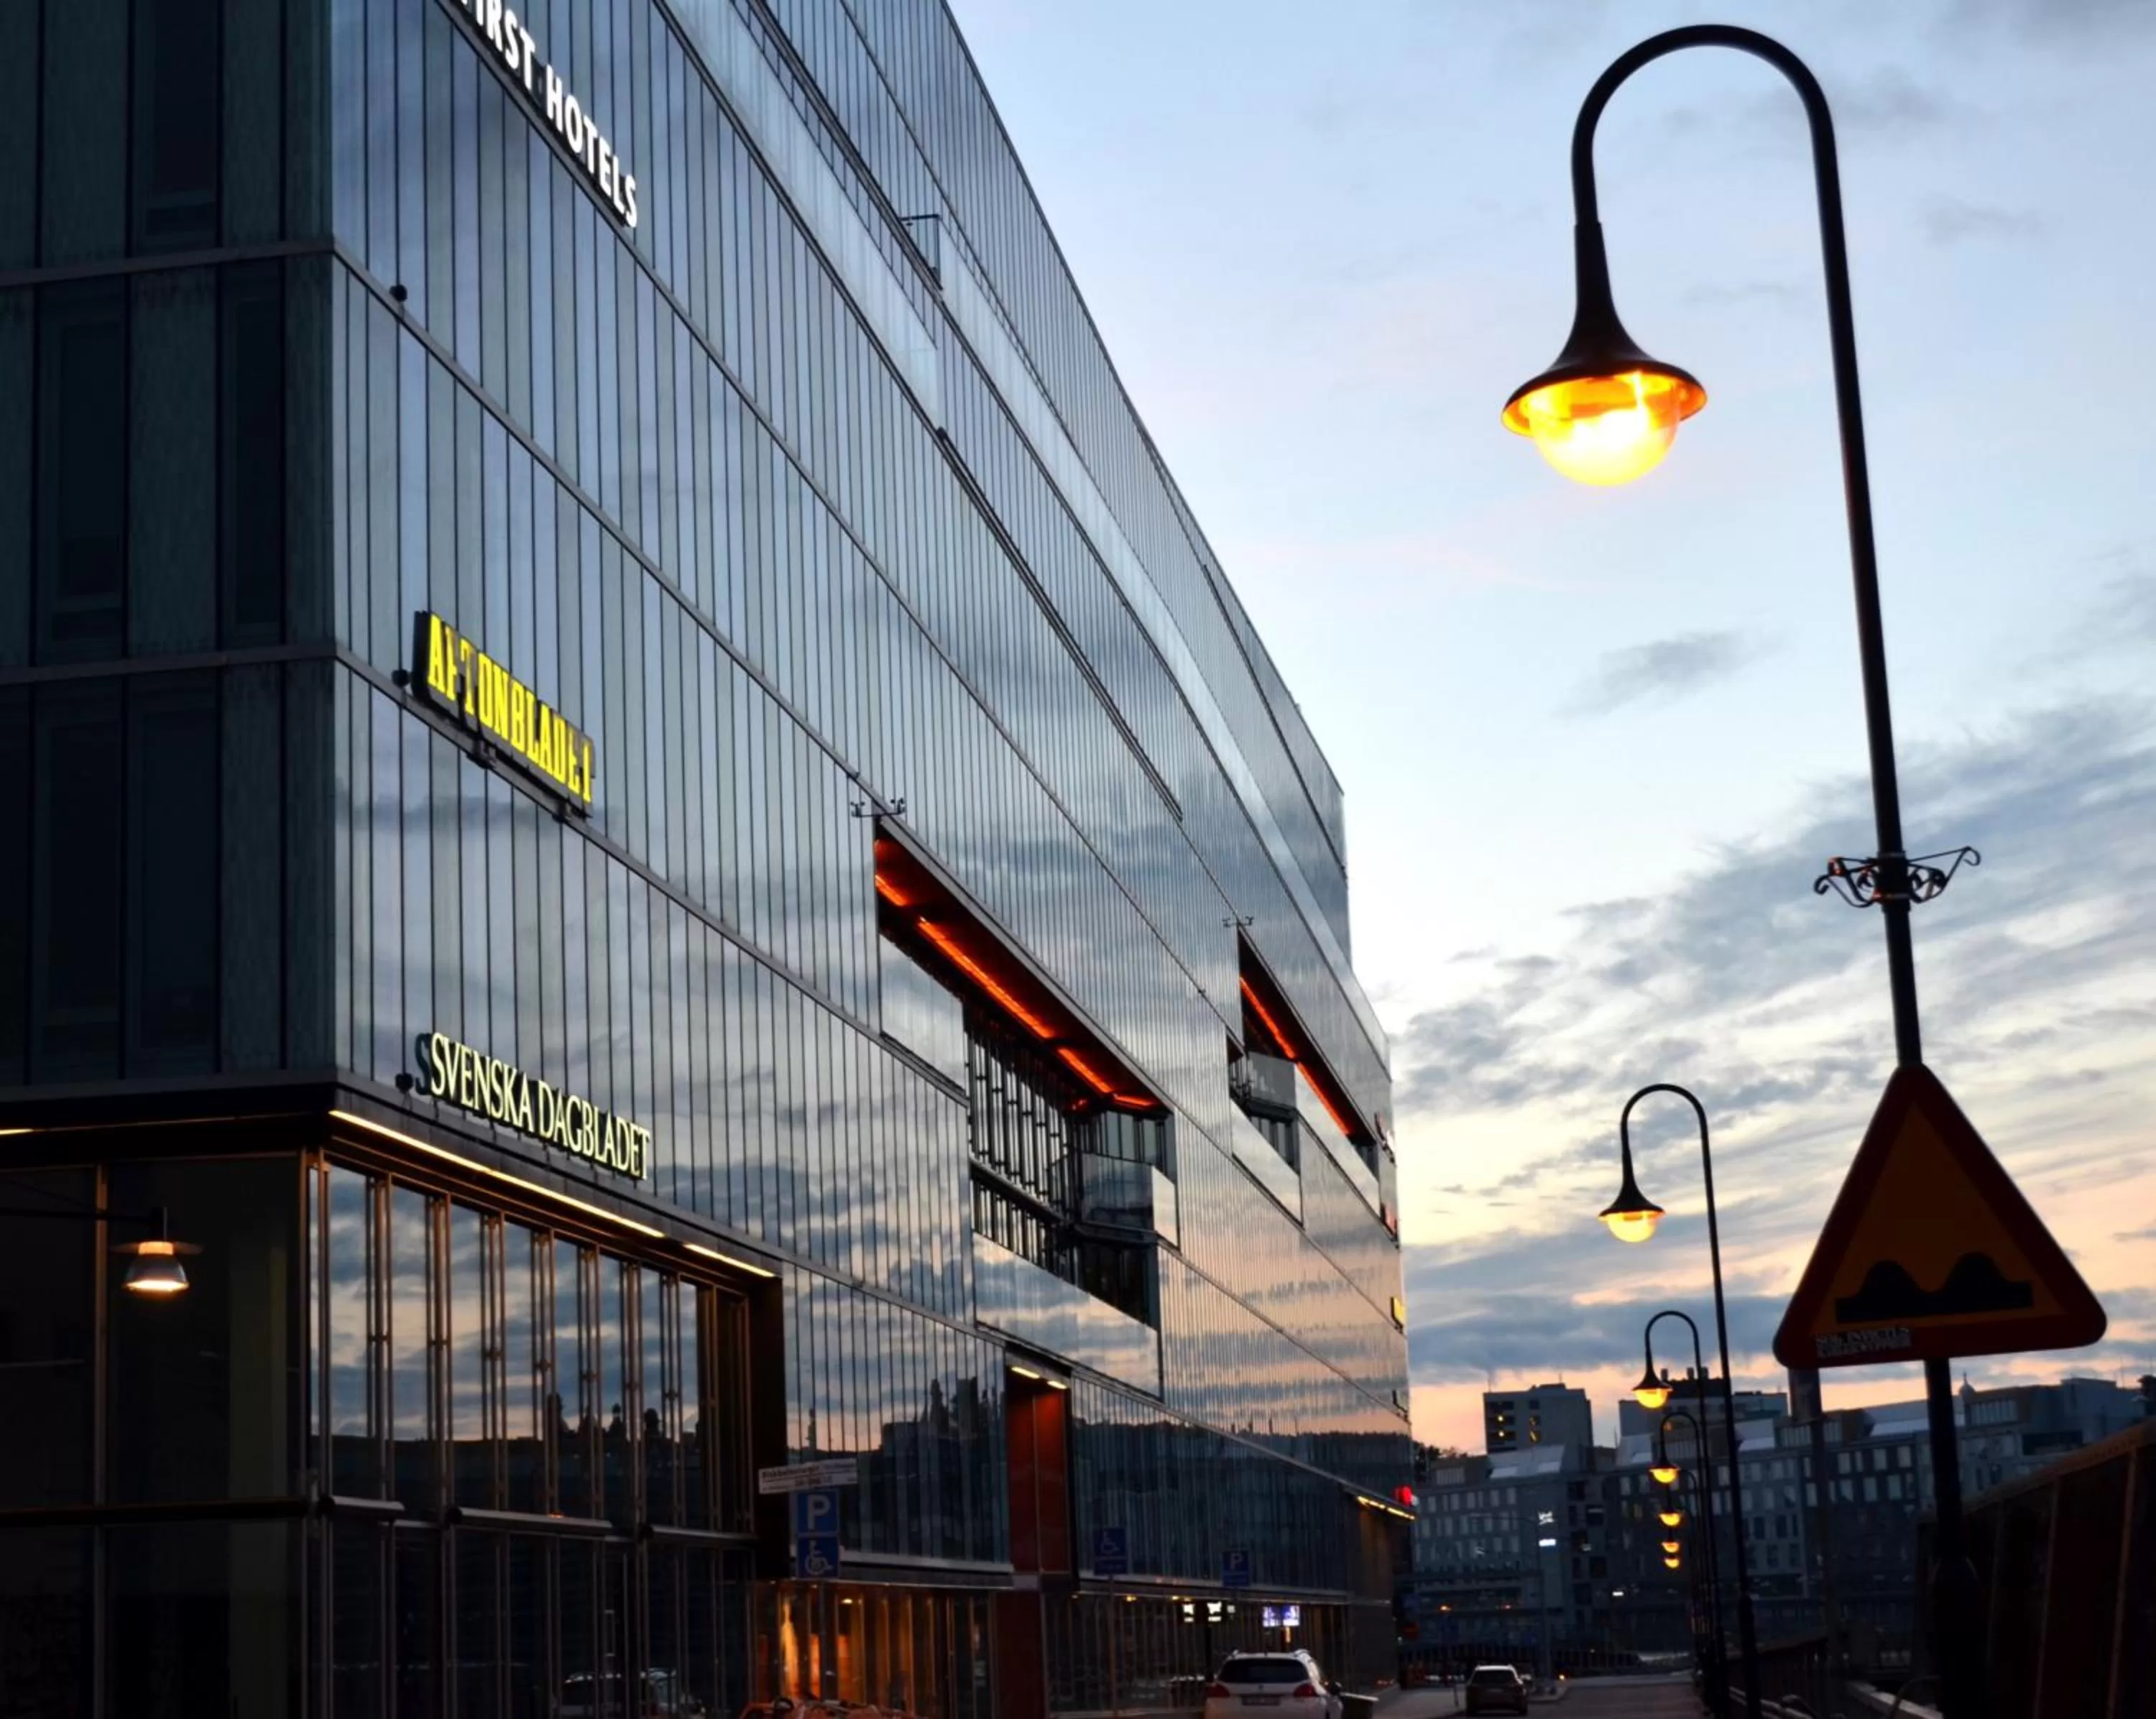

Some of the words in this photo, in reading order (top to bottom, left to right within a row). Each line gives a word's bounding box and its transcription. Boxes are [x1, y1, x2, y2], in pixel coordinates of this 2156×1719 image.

[545, 64, 637, 229] HOTELS
[427, 612, 592, 803] AFTONBLADET
[430, 1032, 534, 1133] SVENSKA
[538, 1079, 650, 1181] DAGBLADET
[807, 1495, 831, 1529] P
[1230, 1552, 1245, 1570] P
